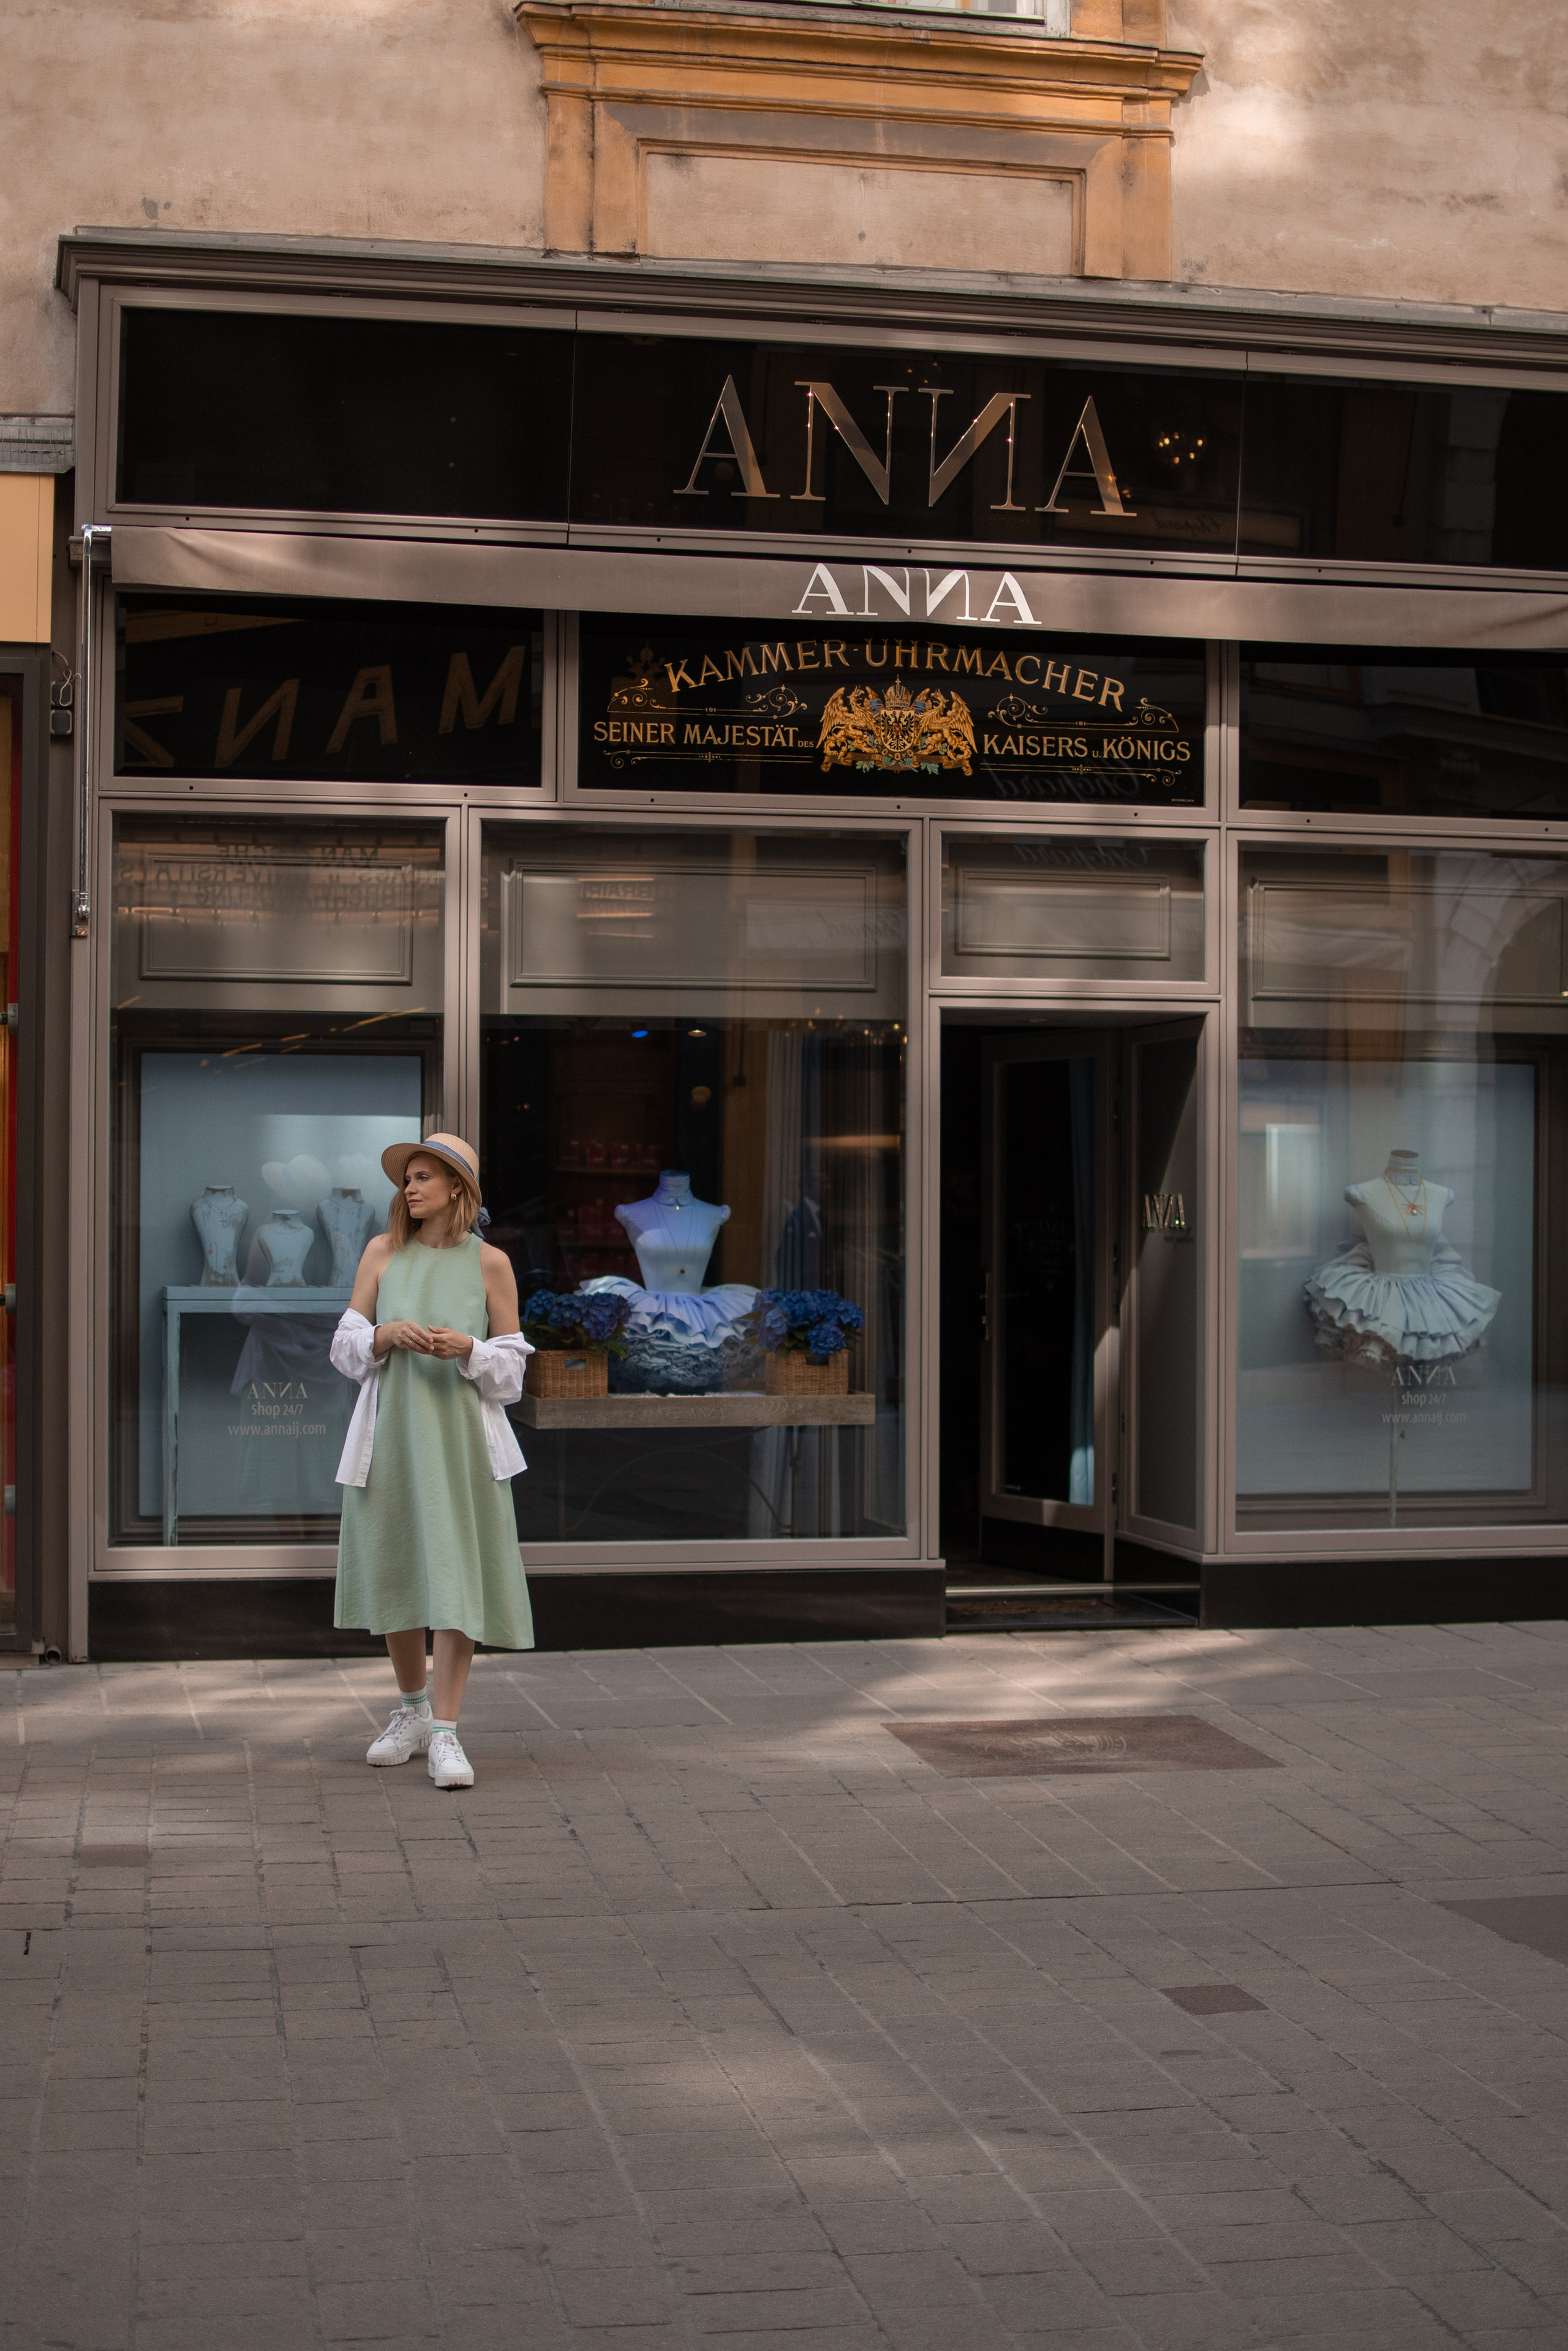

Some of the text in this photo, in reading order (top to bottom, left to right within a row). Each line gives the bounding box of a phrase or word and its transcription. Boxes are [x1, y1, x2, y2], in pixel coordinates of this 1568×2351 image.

[594, 721, 676, 744] SEINER
[683, 723, 799, 747] MAJESTÄT
[798, 740, 814, 749] DES
[983, 734, 1088, 758] KAISERS
[1102, 736, 1191, 761] KÖNIGS
[1401, 1391, 1447, 1408] shop 24/7
[251, 1401, 304, 1419] shop 24/7
[1381, 1411, 1466, 1425] www.annaij.com
[228, 1422, 326, 1438] www.annaij.com
